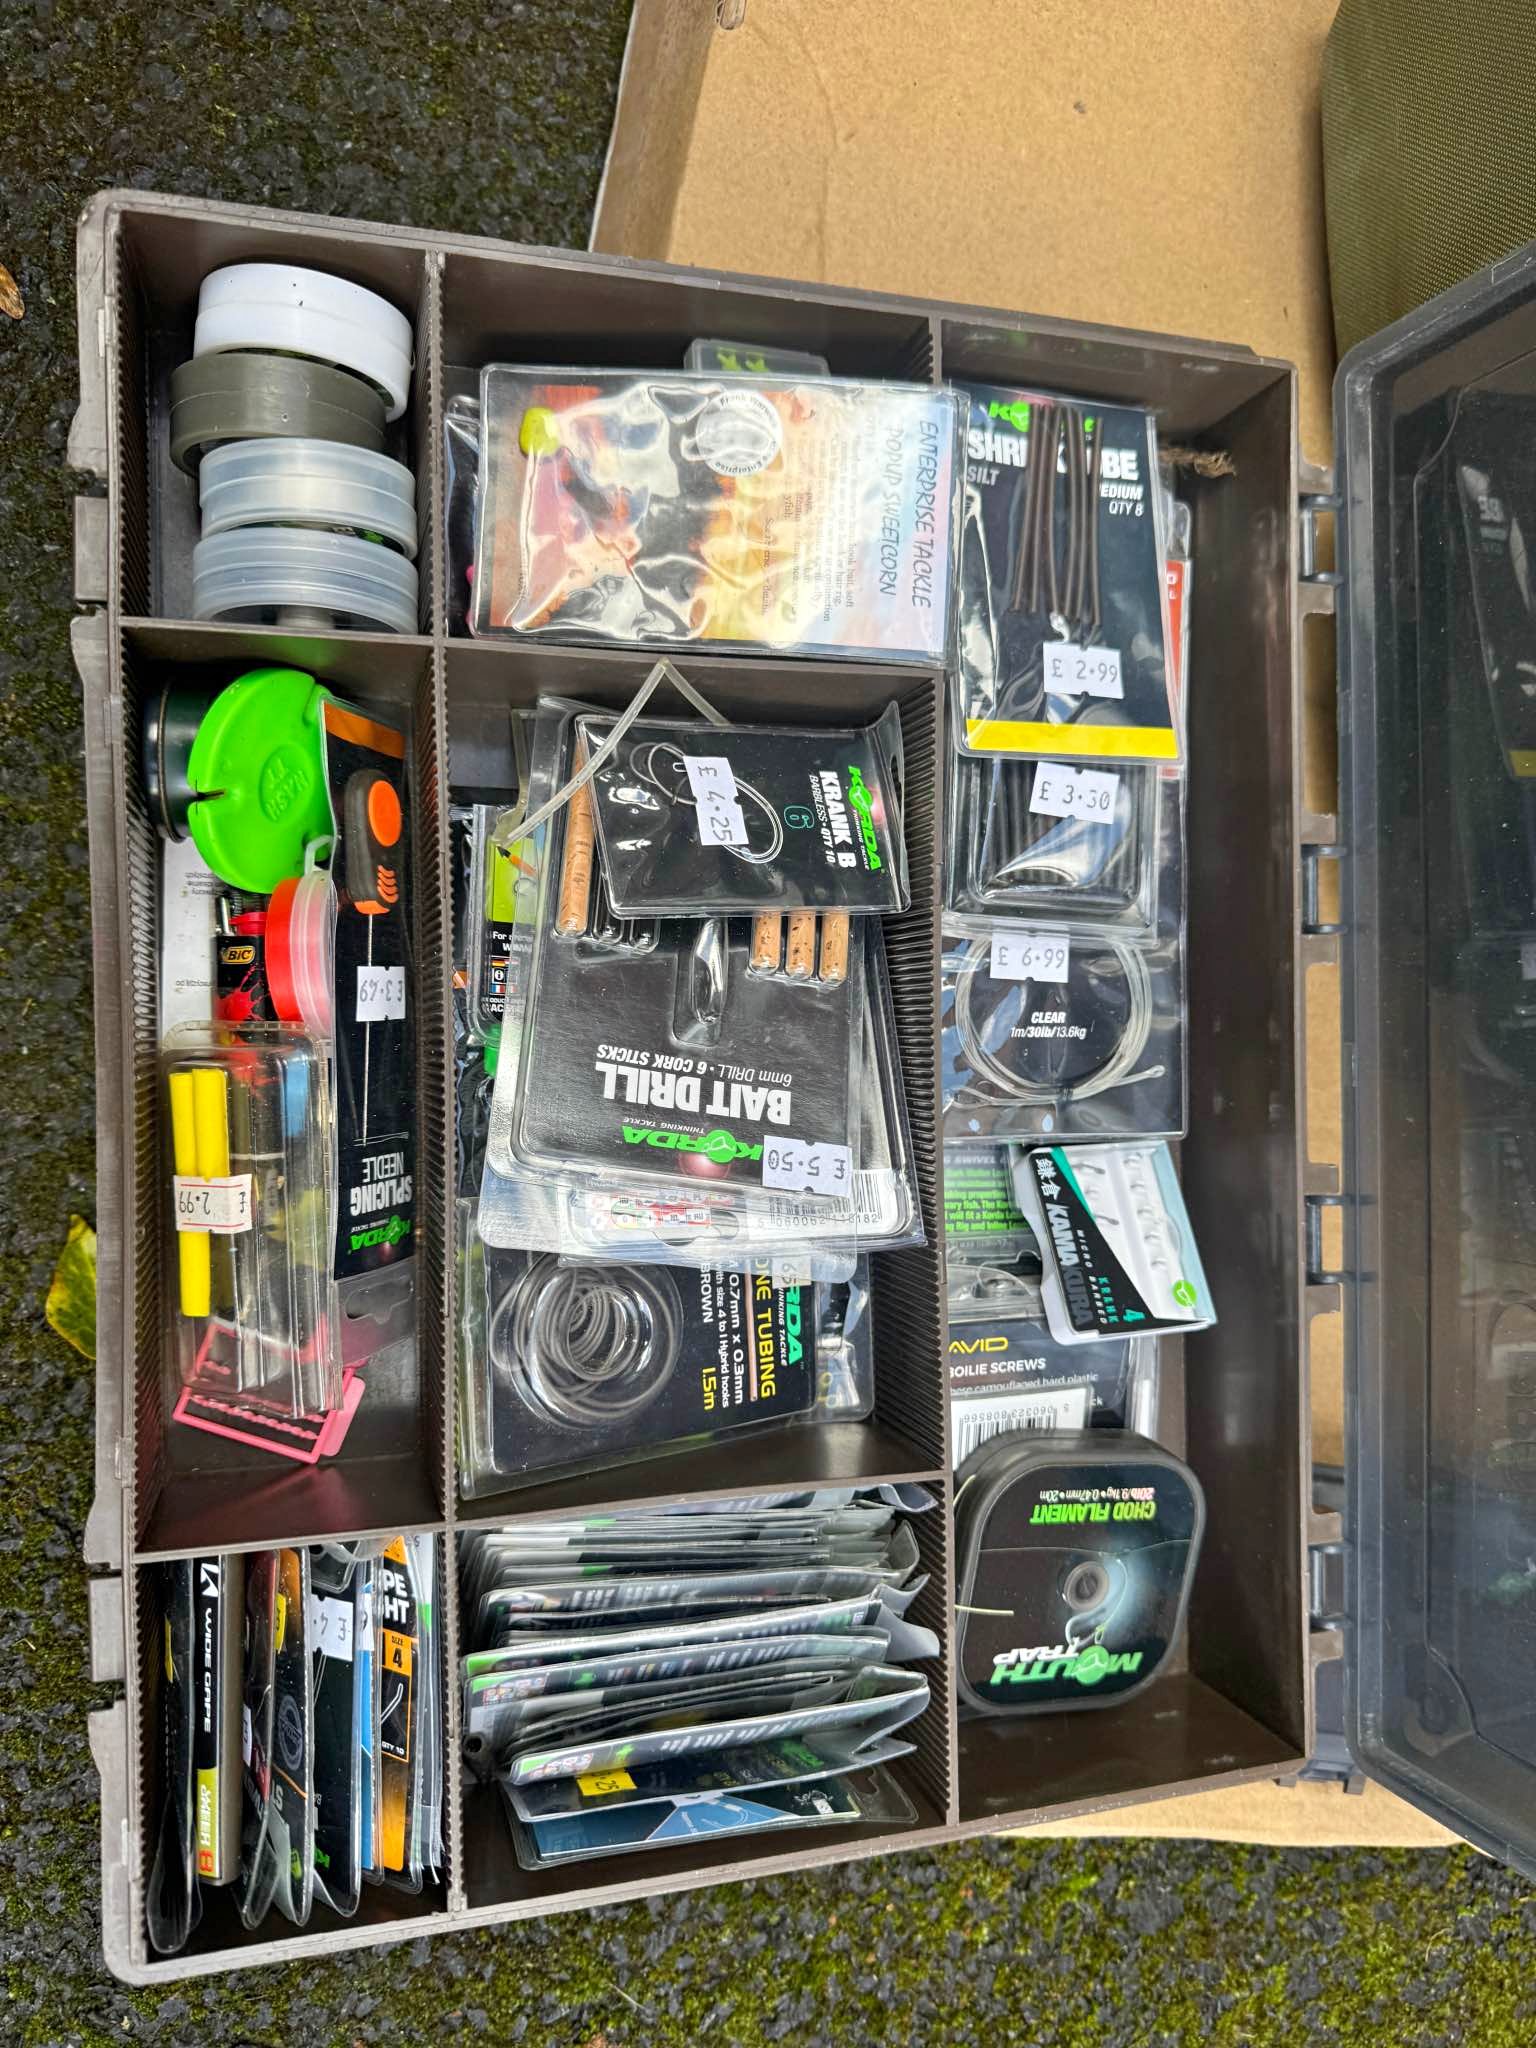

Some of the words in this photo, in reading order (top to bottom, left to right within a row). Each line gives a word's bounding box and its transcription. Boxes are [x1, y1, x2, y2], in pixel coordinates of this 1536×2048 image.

[882, 428, 904, 486] POPUP
[914, 420, 939, 535] ENTERPRISE
[967, 464, 1001, 487] SILT
[1095, 484, 1144, 502] EDIUM
[1108, 502, 1133, 516] QTY
[1135, 503, 1145, 517] 8
[879, 489, 901, 598] SWEETCORN
[911, 539, 935, 609] TACKLE
[1050, 658, 1063, 679] £
[1075, 660, 1119, 683] 2.99
[808, 774, 828, 823] BARBLESS
[1039, 780, 1052, 802] £
[696, 765, 716, 778] £
[708, 790, 733, 843] 4.25
[819, 770, 853, 845] KRANK
[836, 852, 857, 868] B
[820, 827, 835, 848] QTY
[825, 849, 837, 864] 10
[227, 948, 253, 962] BIC
[997, 945, 1009, 967] £
[1022, 947, 1066, 969] 6.99
[1030, 1011, 1067, 1025] CLEAR
[596, 1044, 649, 1067] STICKS
[653, 1052, 694, 1075] CORK
[696, 1061, 708, 1076] 6
[717, 1062, 756, 1083] DRILL
[759, 1067, 793, 1089] 6mm
[595, 1061, 701, 1115] DRILL
[705, 1080, 792, 1127] BAIT
[622, 1117, 657, 1129] TACKLE
[661, 1121, 705, 1135] THINKING
[621, 1128, 764, 1166] KORDA
[361, 1151, 405, 1183] NEEDLE
[767, 1149, 821, 1179] 5.50
[833, 1158, 848, 1181] £
[178, 1191, 211, 1216] 2.99
[350, 1174, 413, 1217] SPLICING
[1045, 1202, 1095, 1327] KAMAKURA
[1076, 1229, 1093, 1269] MICRO
[1088, 1275, 1108, 1325] BARBED
[700, 1262, 715, 1324] BROWN
[716, 1286, 725, 1308] size
[729, 1273, 742, 1329] 0.7mm
[1098, 1276, 1120, 1324] KRANK
[1122, 1308, 1146, 1322] 4
[718, 1340, 730, 1374] Hybrid
[759, 1307, 777, 1398] TUBING
[780, 1329, 788, 1367] TACKLE
[948, 1336, 1009, 1355] AVID
[733, 1348, 745, 1405] 0.3mm
[990, 1357, 1047, 1376] SCREWS
[702, 1367, 718, 1411] 1.5m
[721, 1376, 730, 1409] hooks
[1039, 1489, 1060, 1502] 20m
[1065, 1488, 1100, 1502] 0.47mm
[1029, 1502, 1111, 1525] FILAMENT
[1112, 1500, 1157, 1521] CHOD
[204, 1607, 213, 1668] WIDE
[392, 1647, 403, 1669] 4
[993, 1637, 1080, 1665] TRAP
[204, 1671, 212, 1733] GAPE
